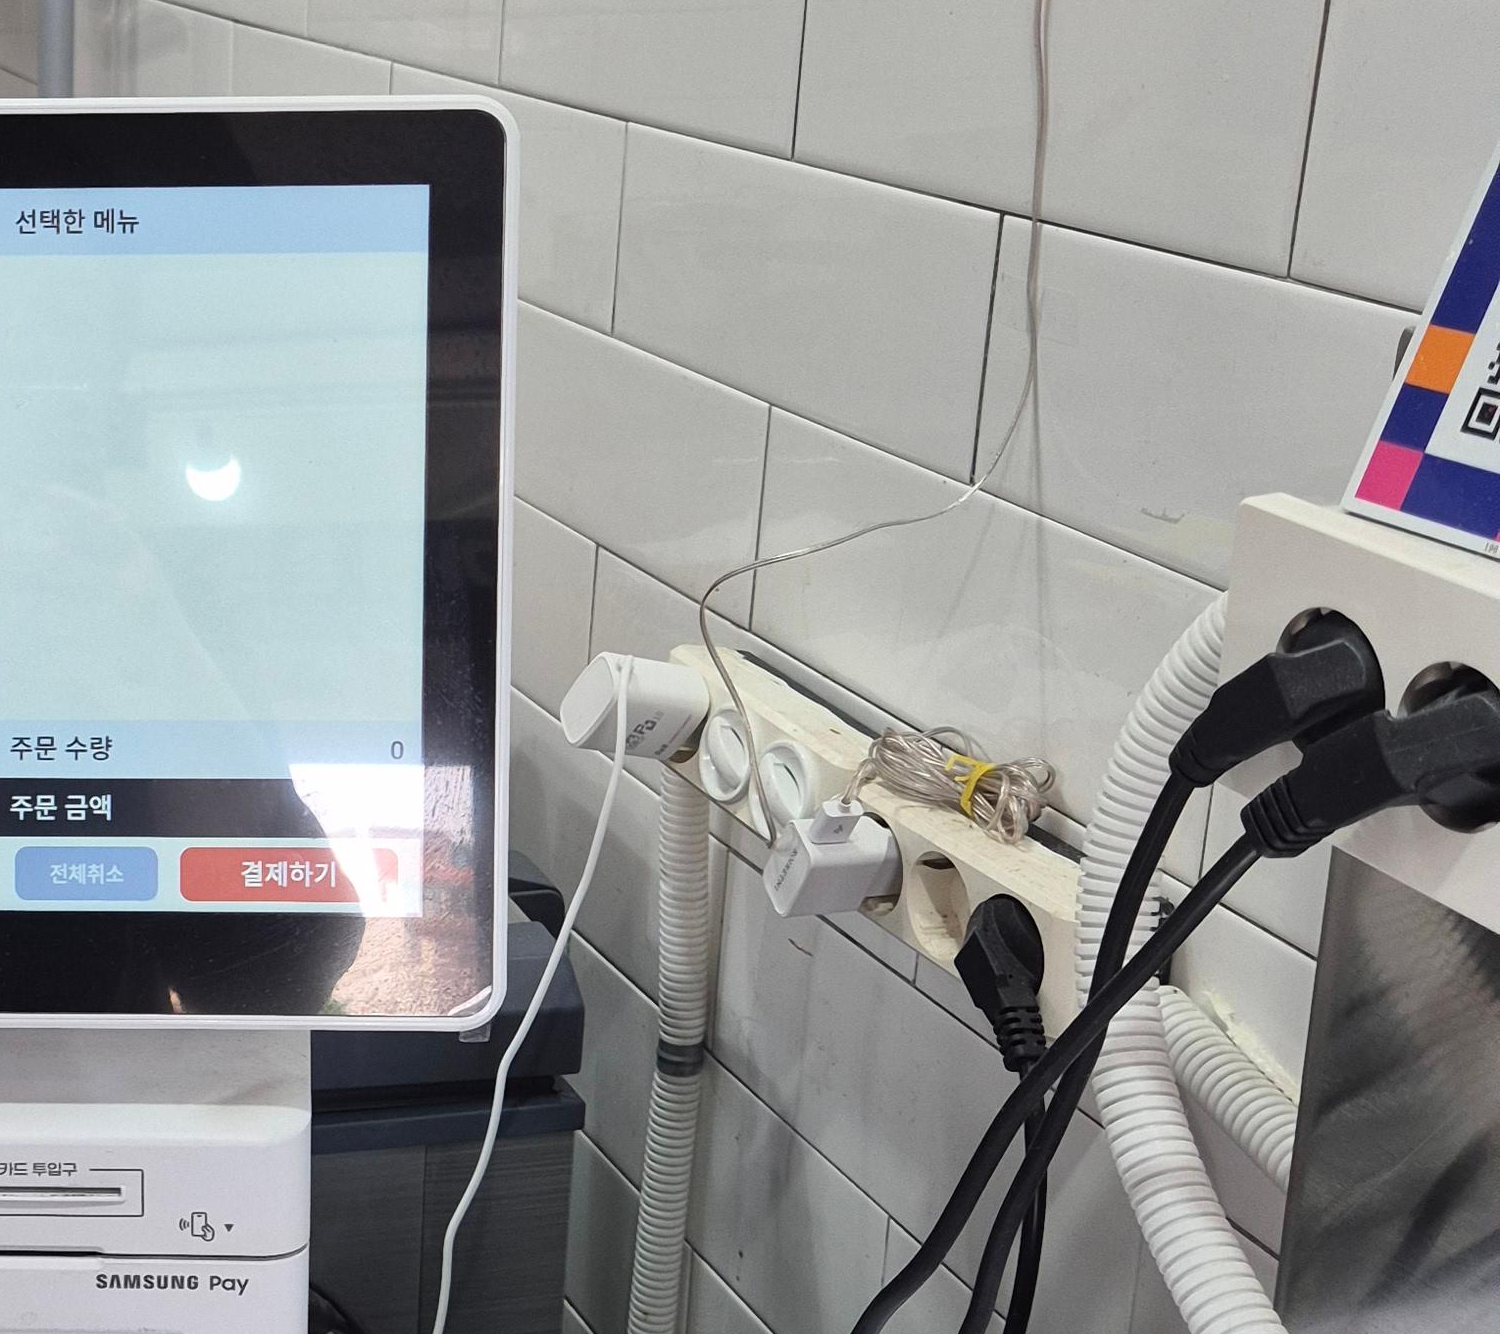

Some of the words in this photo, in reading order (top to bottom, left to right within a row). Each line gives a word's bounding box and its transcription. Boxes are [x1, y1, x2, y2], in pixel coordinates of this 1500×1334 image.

[15, 208, 85, 235] 선택한
[93, 208, 140, 235] 메뉴
[9, 736, 57, 761] 주문
[65, 735, 113, 762] 수량
[390, 740, 404, 761] 0
[9, 795, 58, 821] 주문
[64, 794, 113, 821] 금액
[50, 863, 125, 885] 전체취소
[240, 860, 336, 888] 결제하기
[32, 1162, 78, 1177] 투입구
[95, 1274, 199, 1290] SAMSUNG
[209, 1275, 249, 1296] Pay
